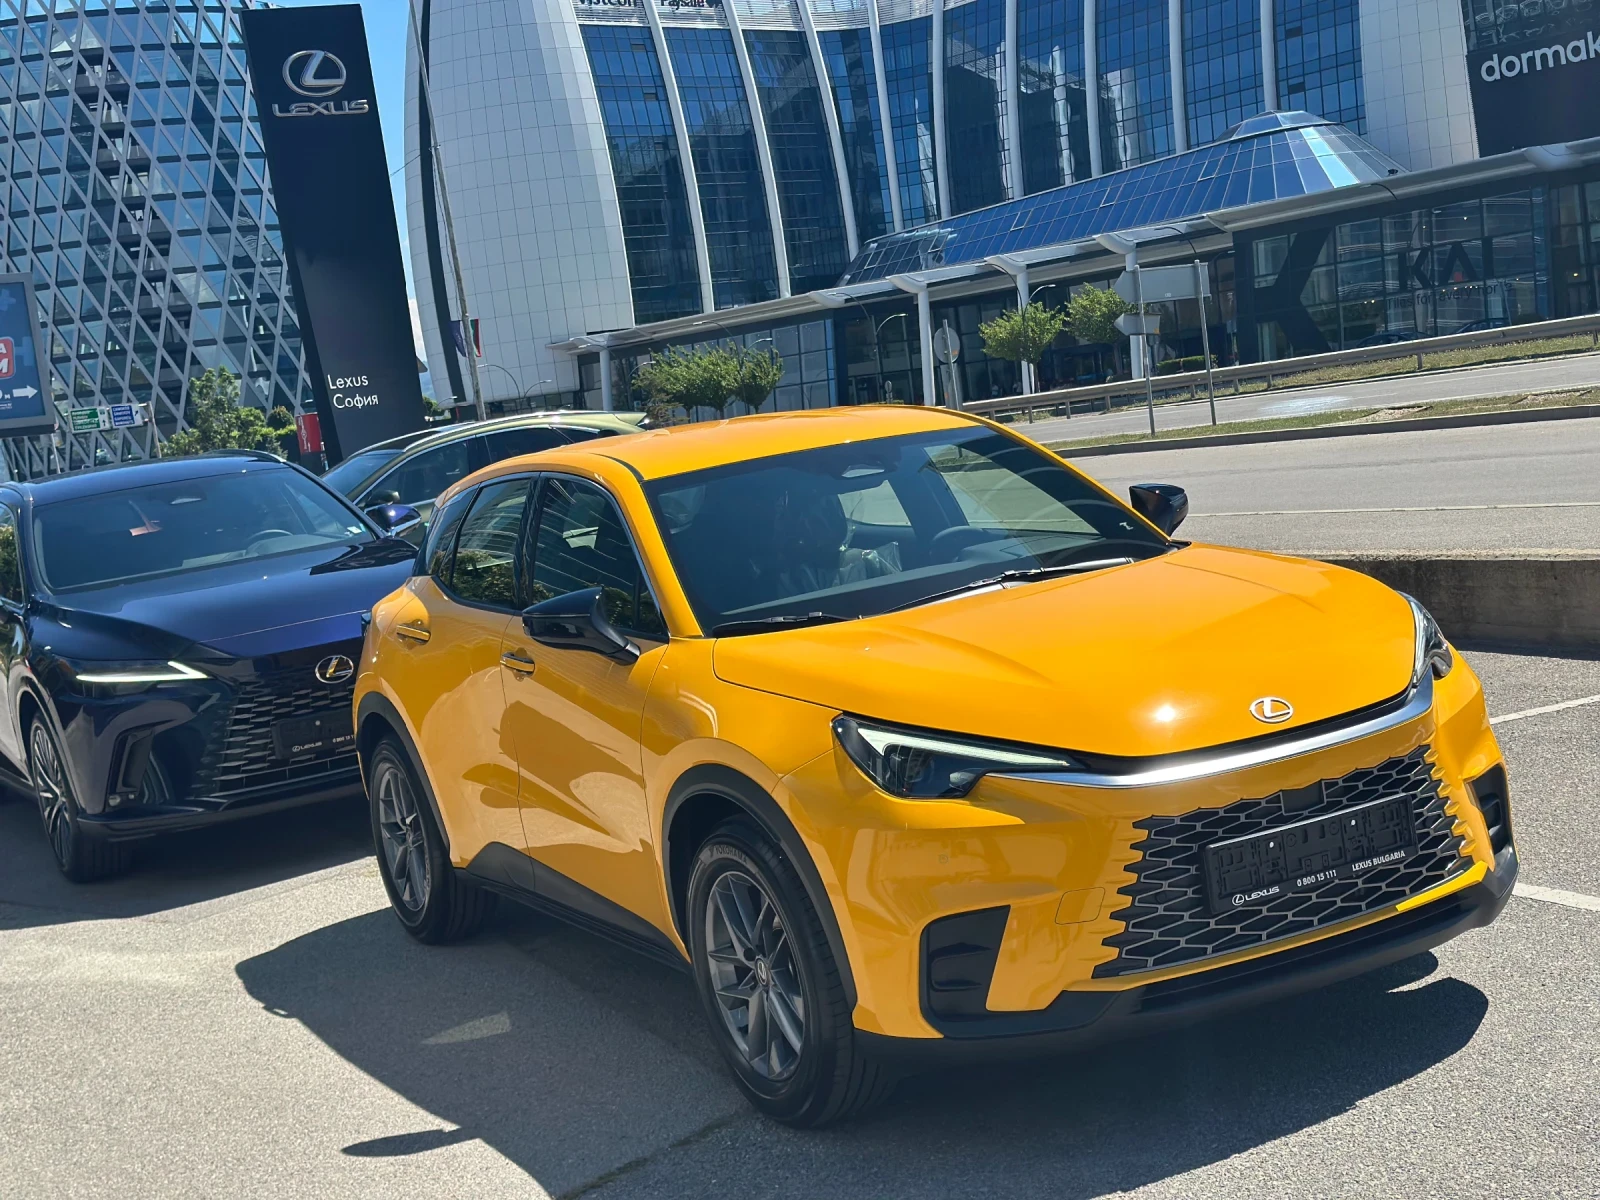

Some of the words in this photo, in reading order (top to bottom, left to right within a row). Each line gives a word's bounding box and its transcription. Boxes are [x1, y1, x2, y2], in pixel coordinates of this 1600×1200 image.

[272, 99, 369, 118] LEXUS
[1416, 292, 1432, 305] for
[327, 374, 369, 390] Lexus
[333, 393, 379, 409] София
[1351, 859, 1373, 872] LEXUS
[1373, 850, 1406, 867] BULGARIA
[1296, 879, 1302, 887] 0
[1302, 875, 1316, 885] 800
[1317, 873, 1325, 882] 15
[1325, 869, 1337, 880] 111
[1245, 885, 1280, 901] LEXUS
